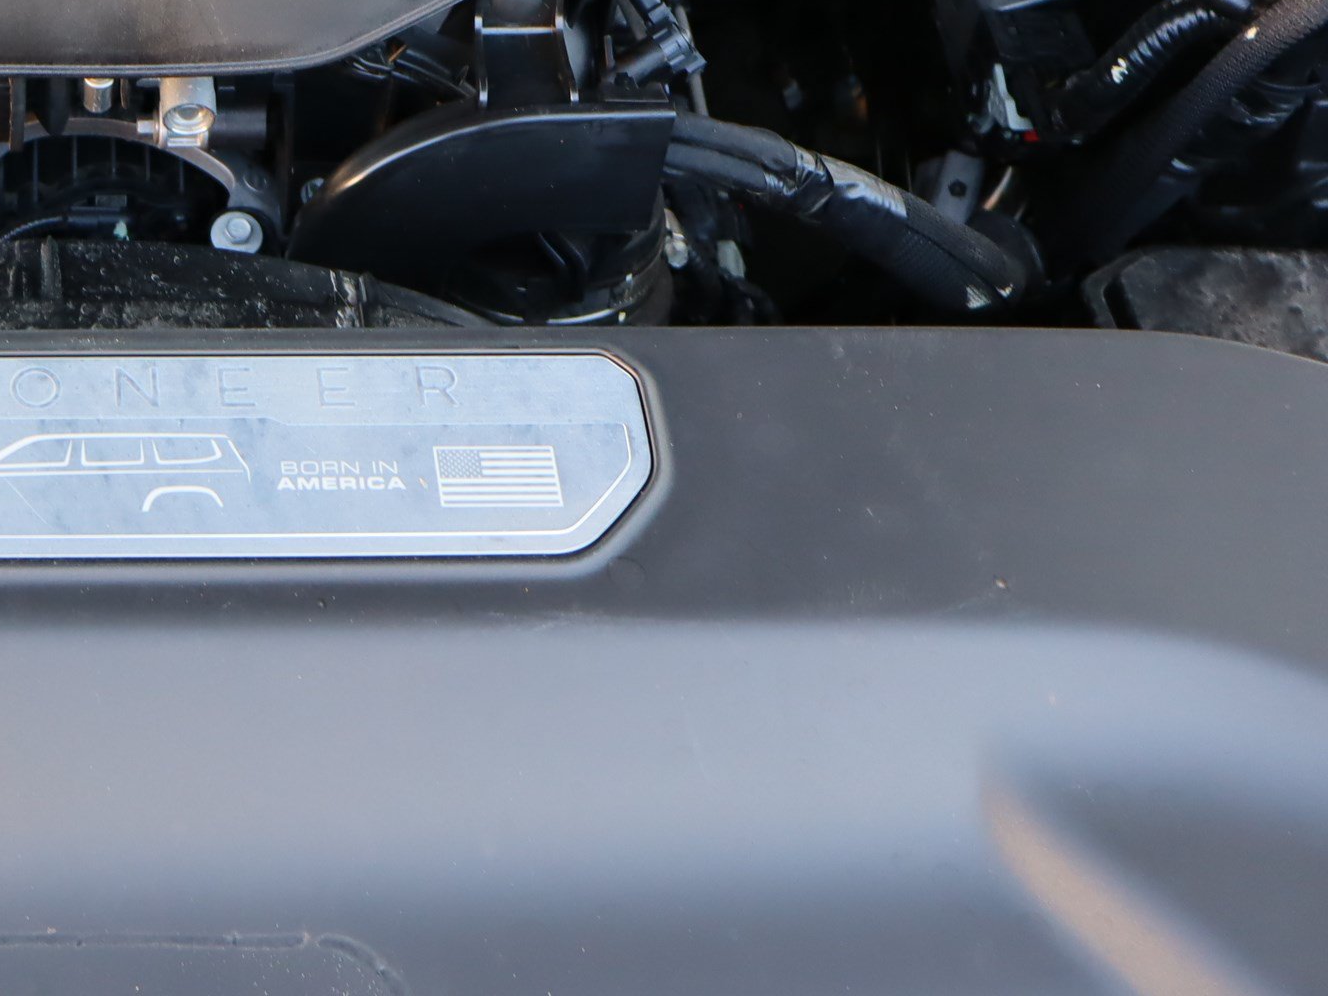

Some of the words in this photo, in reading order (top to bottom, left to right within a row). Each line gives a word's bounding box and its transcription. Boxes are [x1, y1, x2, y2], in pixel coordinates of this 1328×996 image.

[280, 460, 360, 475] BORN
[372, 460, 399, 475] IN
[277, 476, 407, 491] AMERICA
